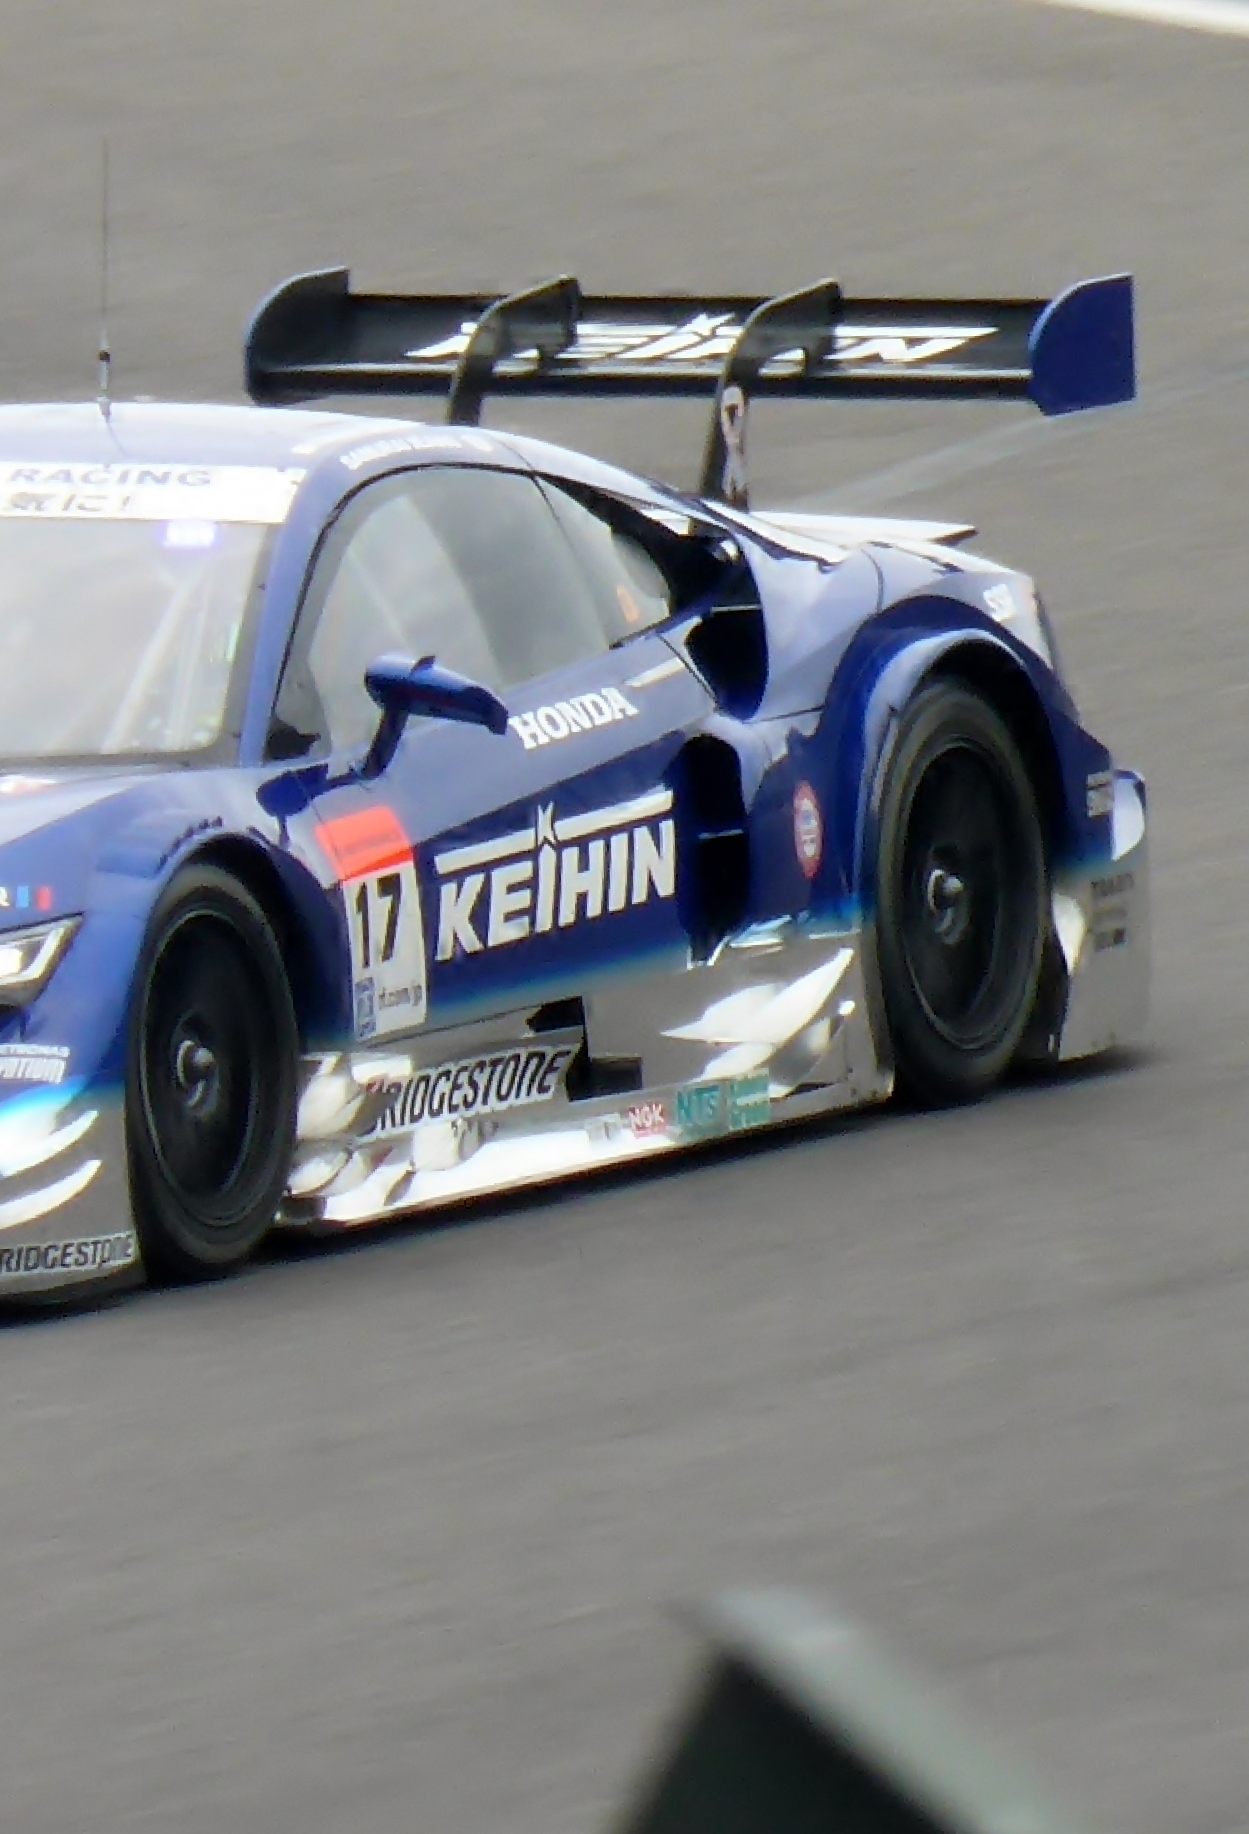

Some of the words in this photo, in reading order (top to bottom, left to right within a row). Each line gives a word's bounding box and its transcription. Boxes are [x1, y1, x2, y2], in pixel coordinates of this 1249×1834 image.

[7, 467, 213, 487] RACING
[508, 687, 640, 750] HONDA
[354, 871, 403, 970] 17
[434, 798, 676, 962] KEIHIN
